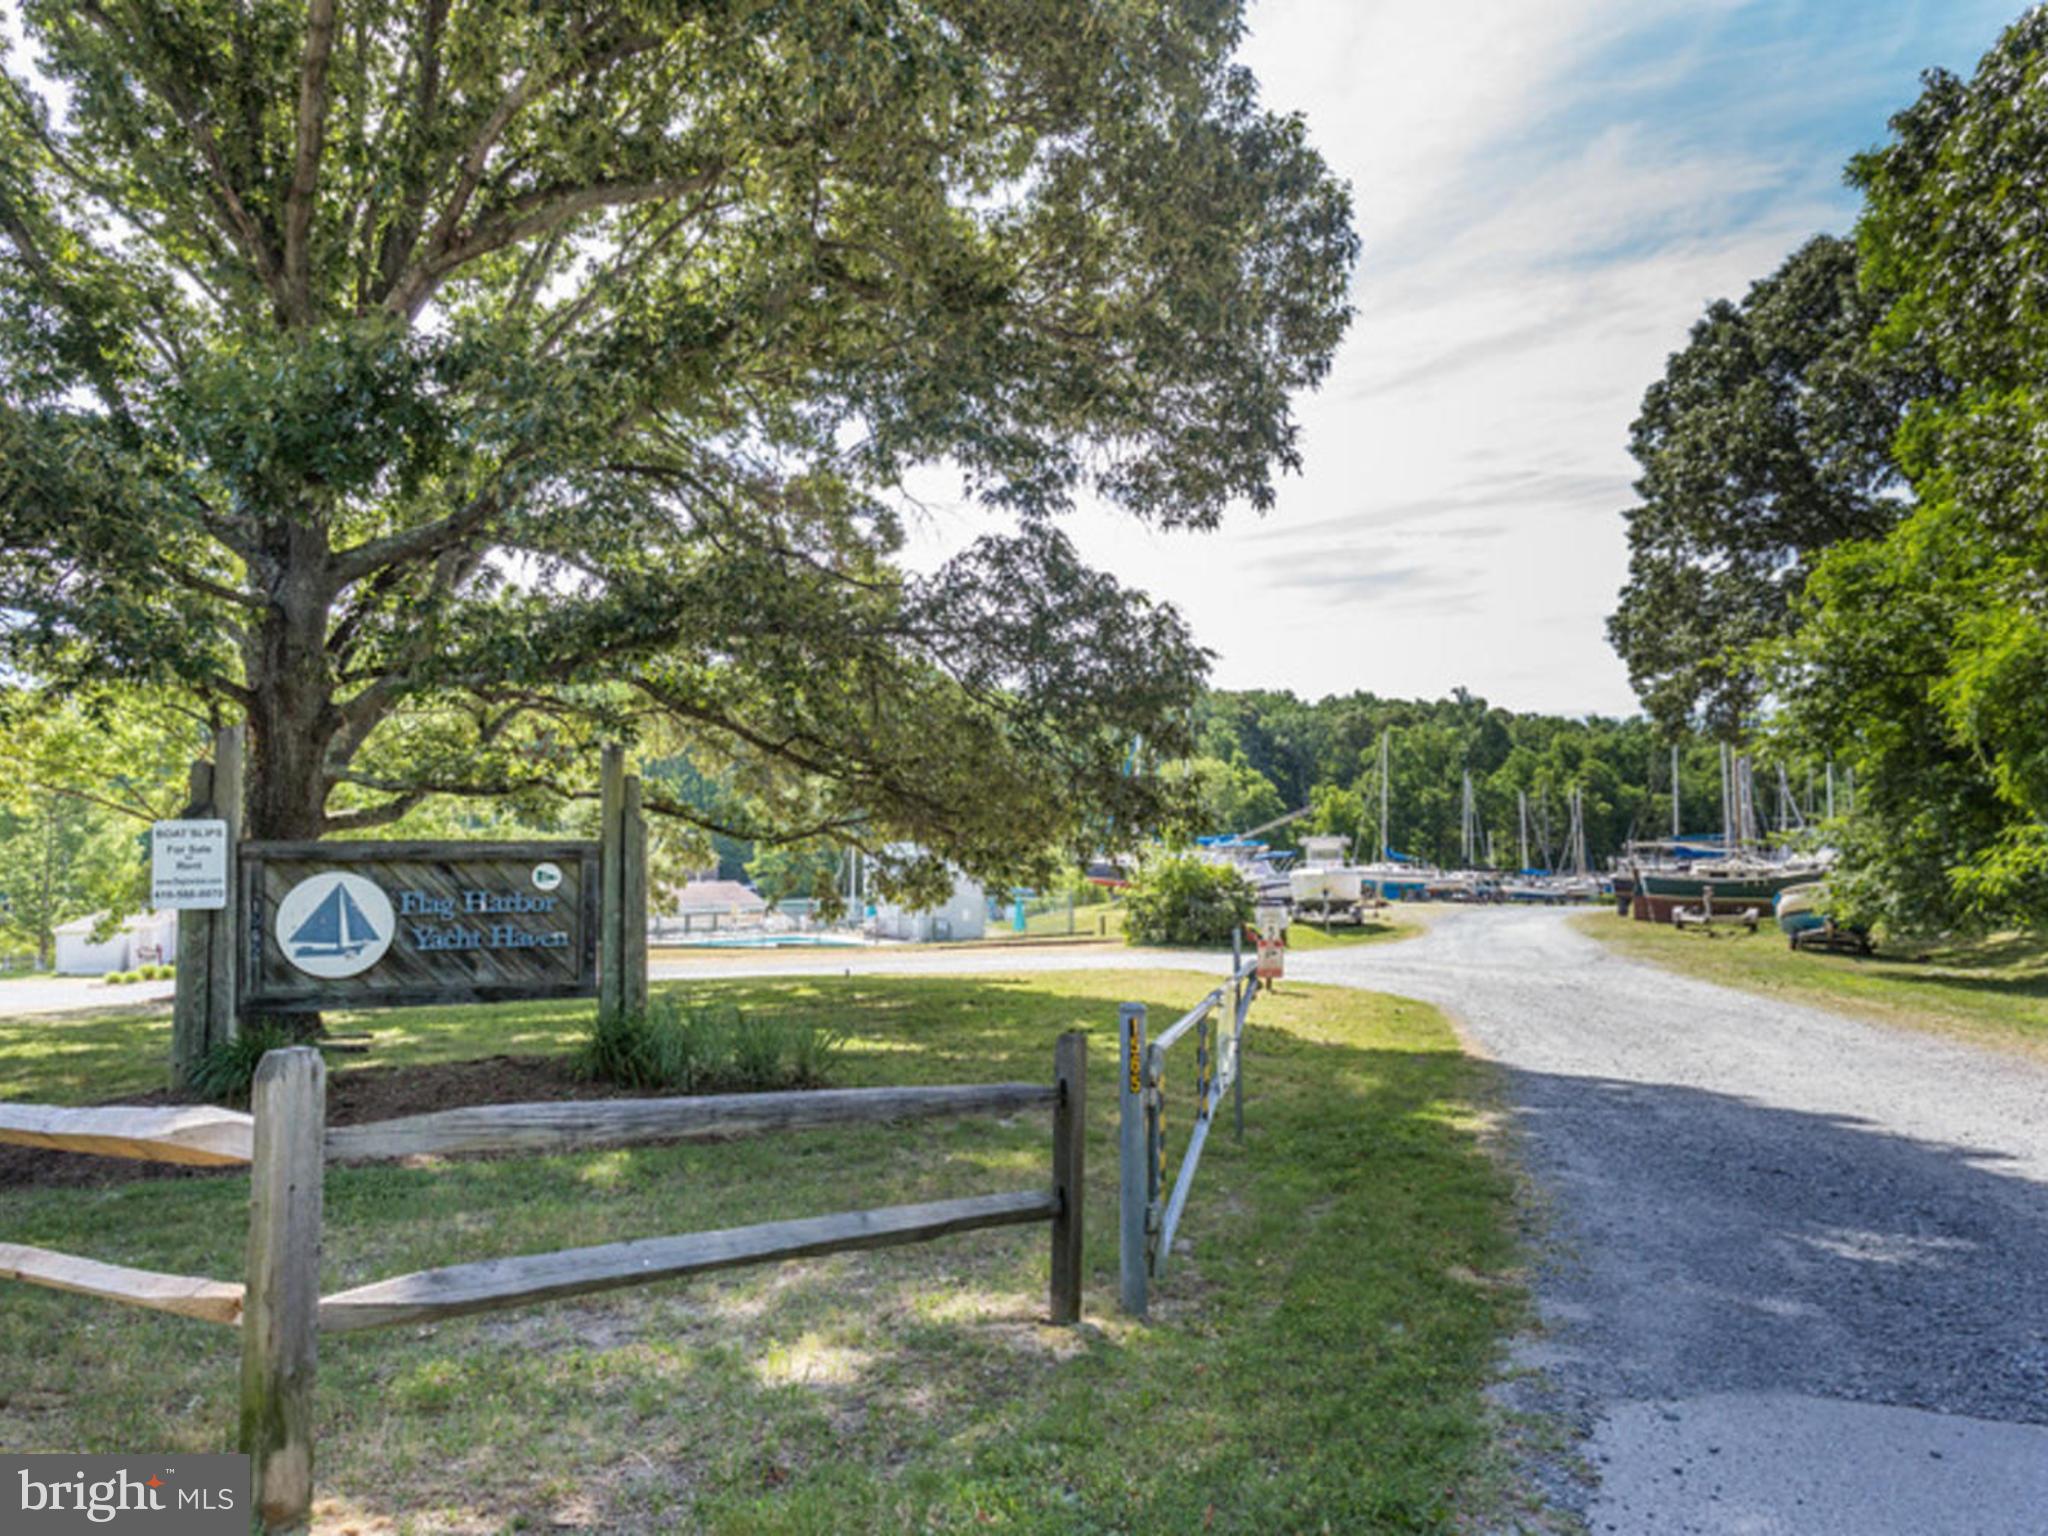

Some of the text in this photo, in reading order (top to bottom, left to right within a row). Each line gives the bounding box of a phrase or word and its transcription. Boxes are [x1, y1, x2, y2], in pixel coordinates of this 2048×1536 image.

[155, 828, 222, 838] BOAT SLIPS
[166, 845, 212, 853] For Sale
[399, 890, 558, 920] Flag Harbor
[413, 924, 569, 950] Yacht Haven
